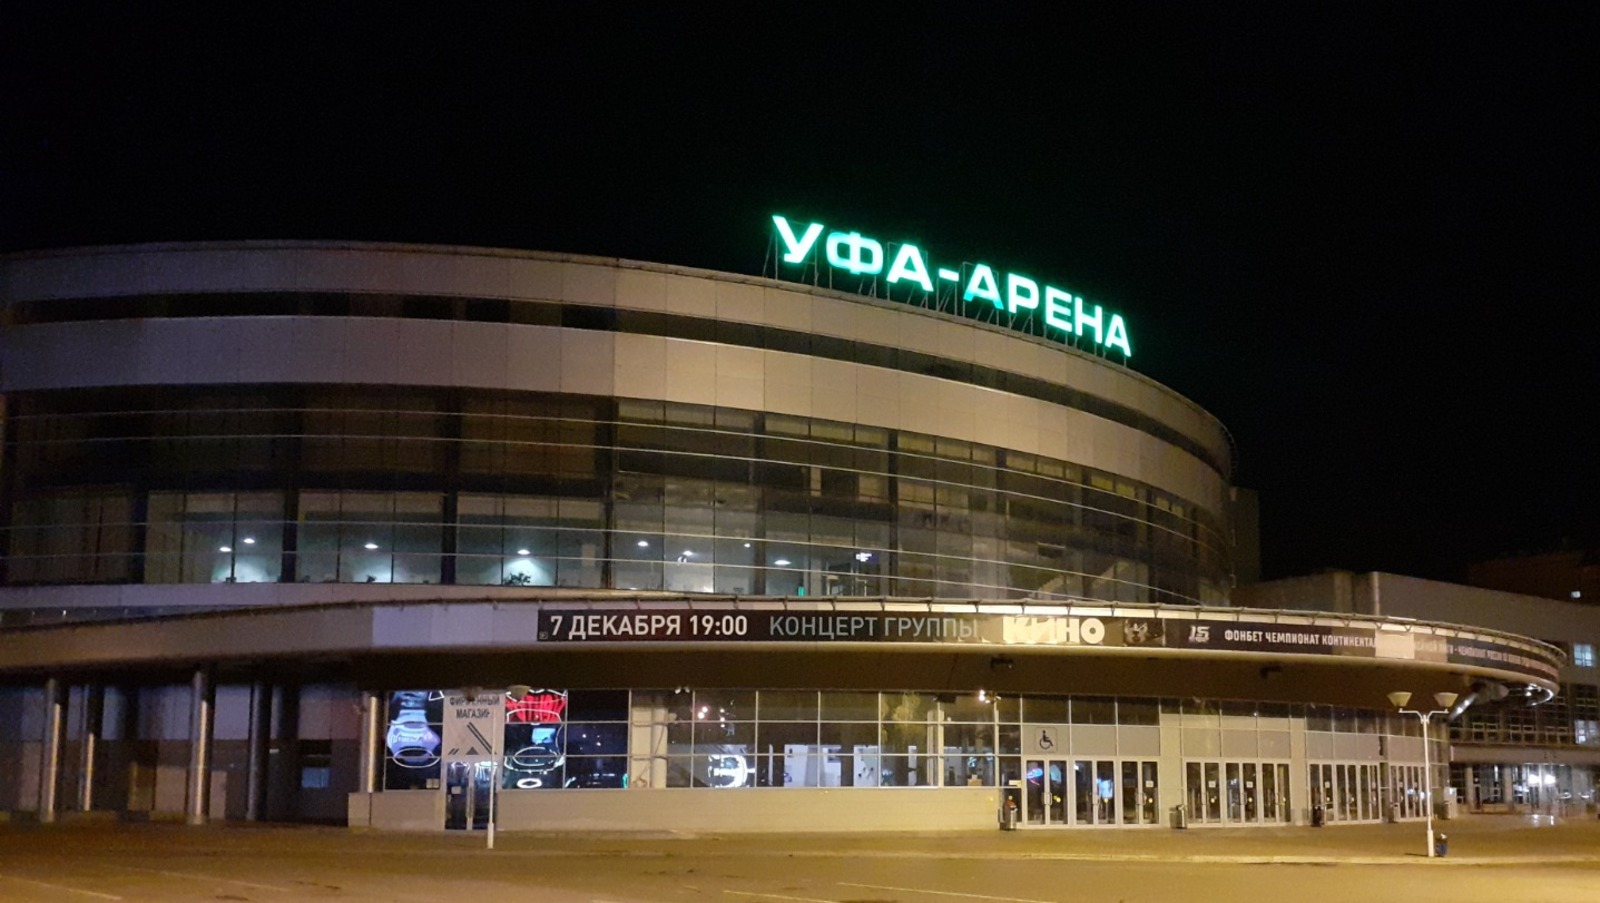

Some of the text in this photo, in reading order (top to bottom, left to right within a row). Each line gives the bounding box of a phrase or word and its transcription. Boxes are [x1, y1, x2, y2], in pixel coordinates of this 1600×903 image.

[772, 215, 1132, 357] УФА-АРЕНА
[550, 615, 563, 636] 7
[568, 615, 681, 640] ДЕКАБРЯ
[689, 615, 748, 636] 19:00
[769, 616, 878, 640] КОНЦЕРТ
[884, 617, 978, 639] ГРУППЫ
[1224, 629, 1263, 643] ФОНБЕТ
[1265, 631, 1320, 646] ЧЕМПИОНАТ
